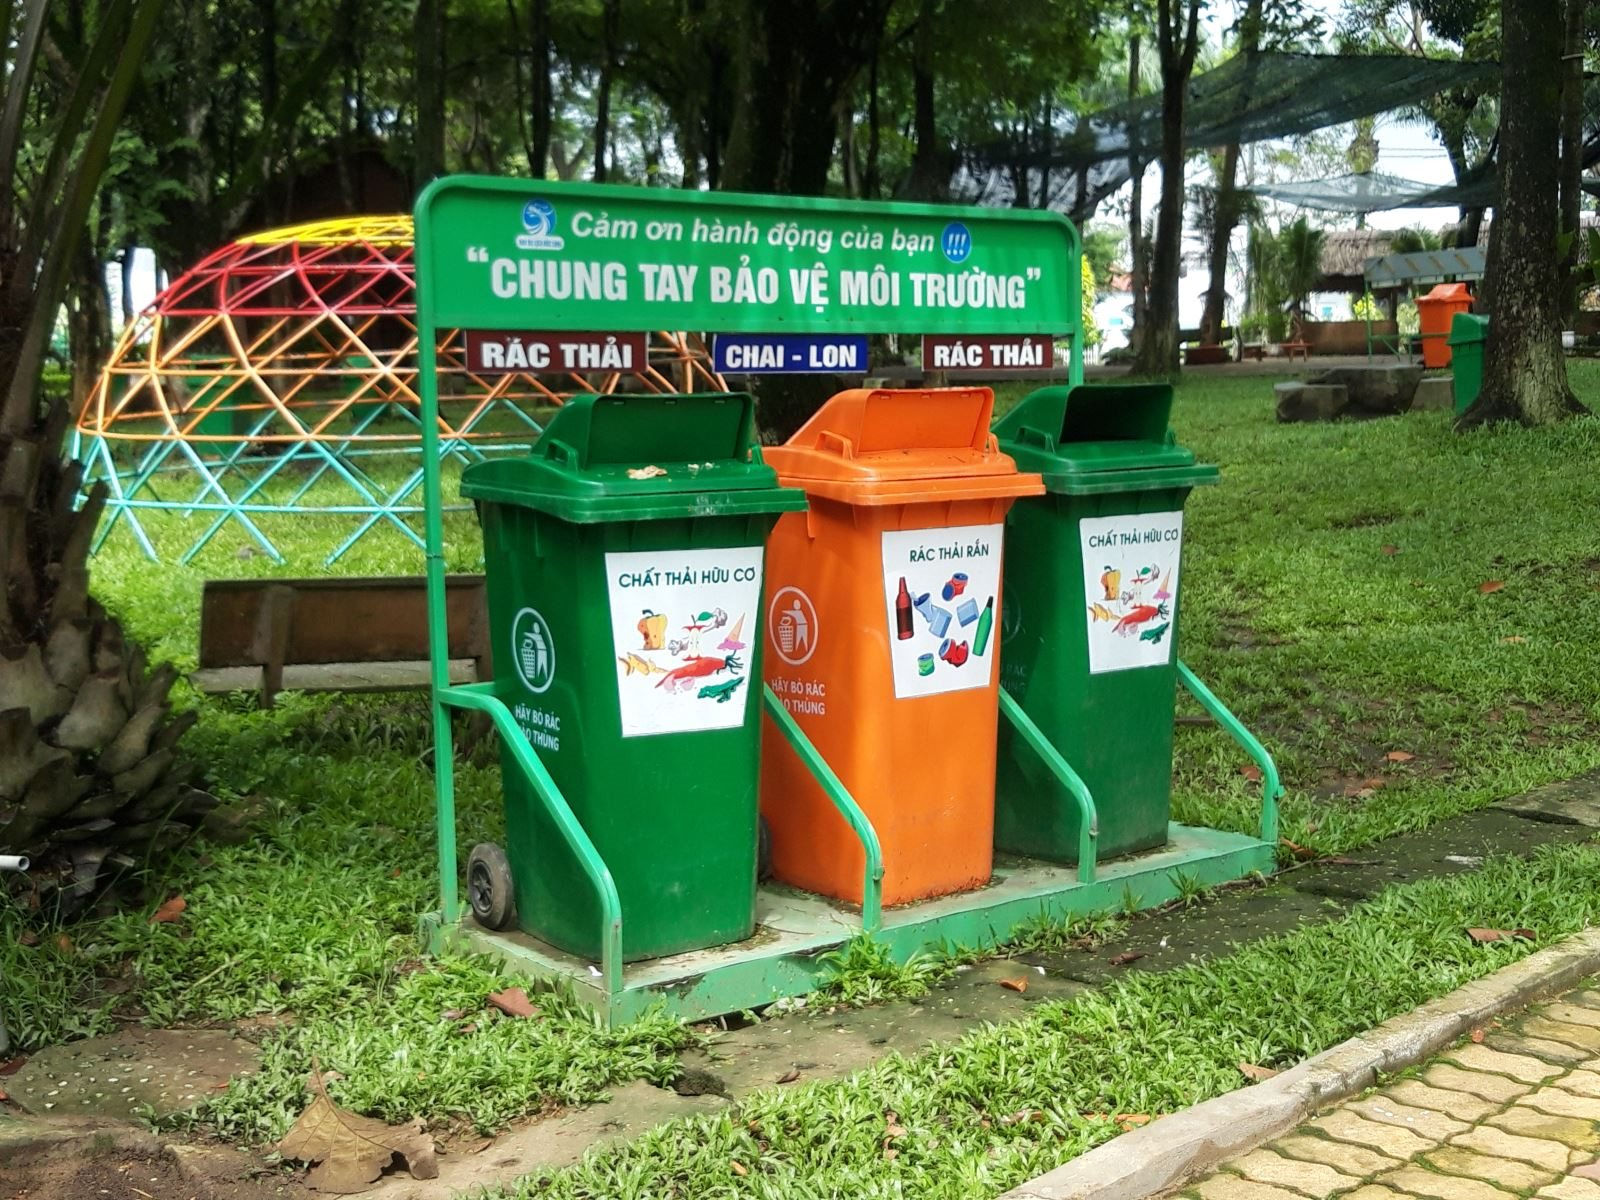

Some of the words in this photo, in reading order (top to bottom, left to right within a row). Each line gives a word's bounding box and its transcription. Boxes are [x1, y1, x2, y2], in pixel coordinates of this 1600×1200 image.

[571, 210, 638, 239] Cảm
[646, 221, 683, 241] ơn
[691, 217, 759, 245] hành
[767, 221, 833, 254] động
[840, 224, 884, 250] của
[891, 228, 934, 257] bạn
[639, 264, 698, 302] TAY
[710, 255, 779, 304] BẢO
[789, 261, 829, 313] VỆ
[840, 264, 900, 307] MÔI
[482, 336, 550, 368] RÁC
[560, 336, 632, 368] THẢI
[725, 344, 784, 368] CHAI
[809, 345, 857, 368] LON
[934, 340, 983, 367] RÁC
[990, 338, 1043, 366] THẢI
[910, 545, 935, 562] RÁC
[938, 541, 963, 560] THẢI
[966, 538, 989, 557] RẮN
[1089, 529, 1117, 548] CHẤT
[1120, 528, 1142, 545] THẢI
[1143, 528, 1162, 543] HỮU
[1164, 528, 1179, 541] CƠ
[618, 566, 661, 588] CHẤT
[665, 566, 697, 586] THẢI
[701, 566, 729, 584] HỮU
[733, 566, 756, 582] CƠ
[805, 679, 826, 697] RÁC
[545, 711, 561, 731] RÁC
